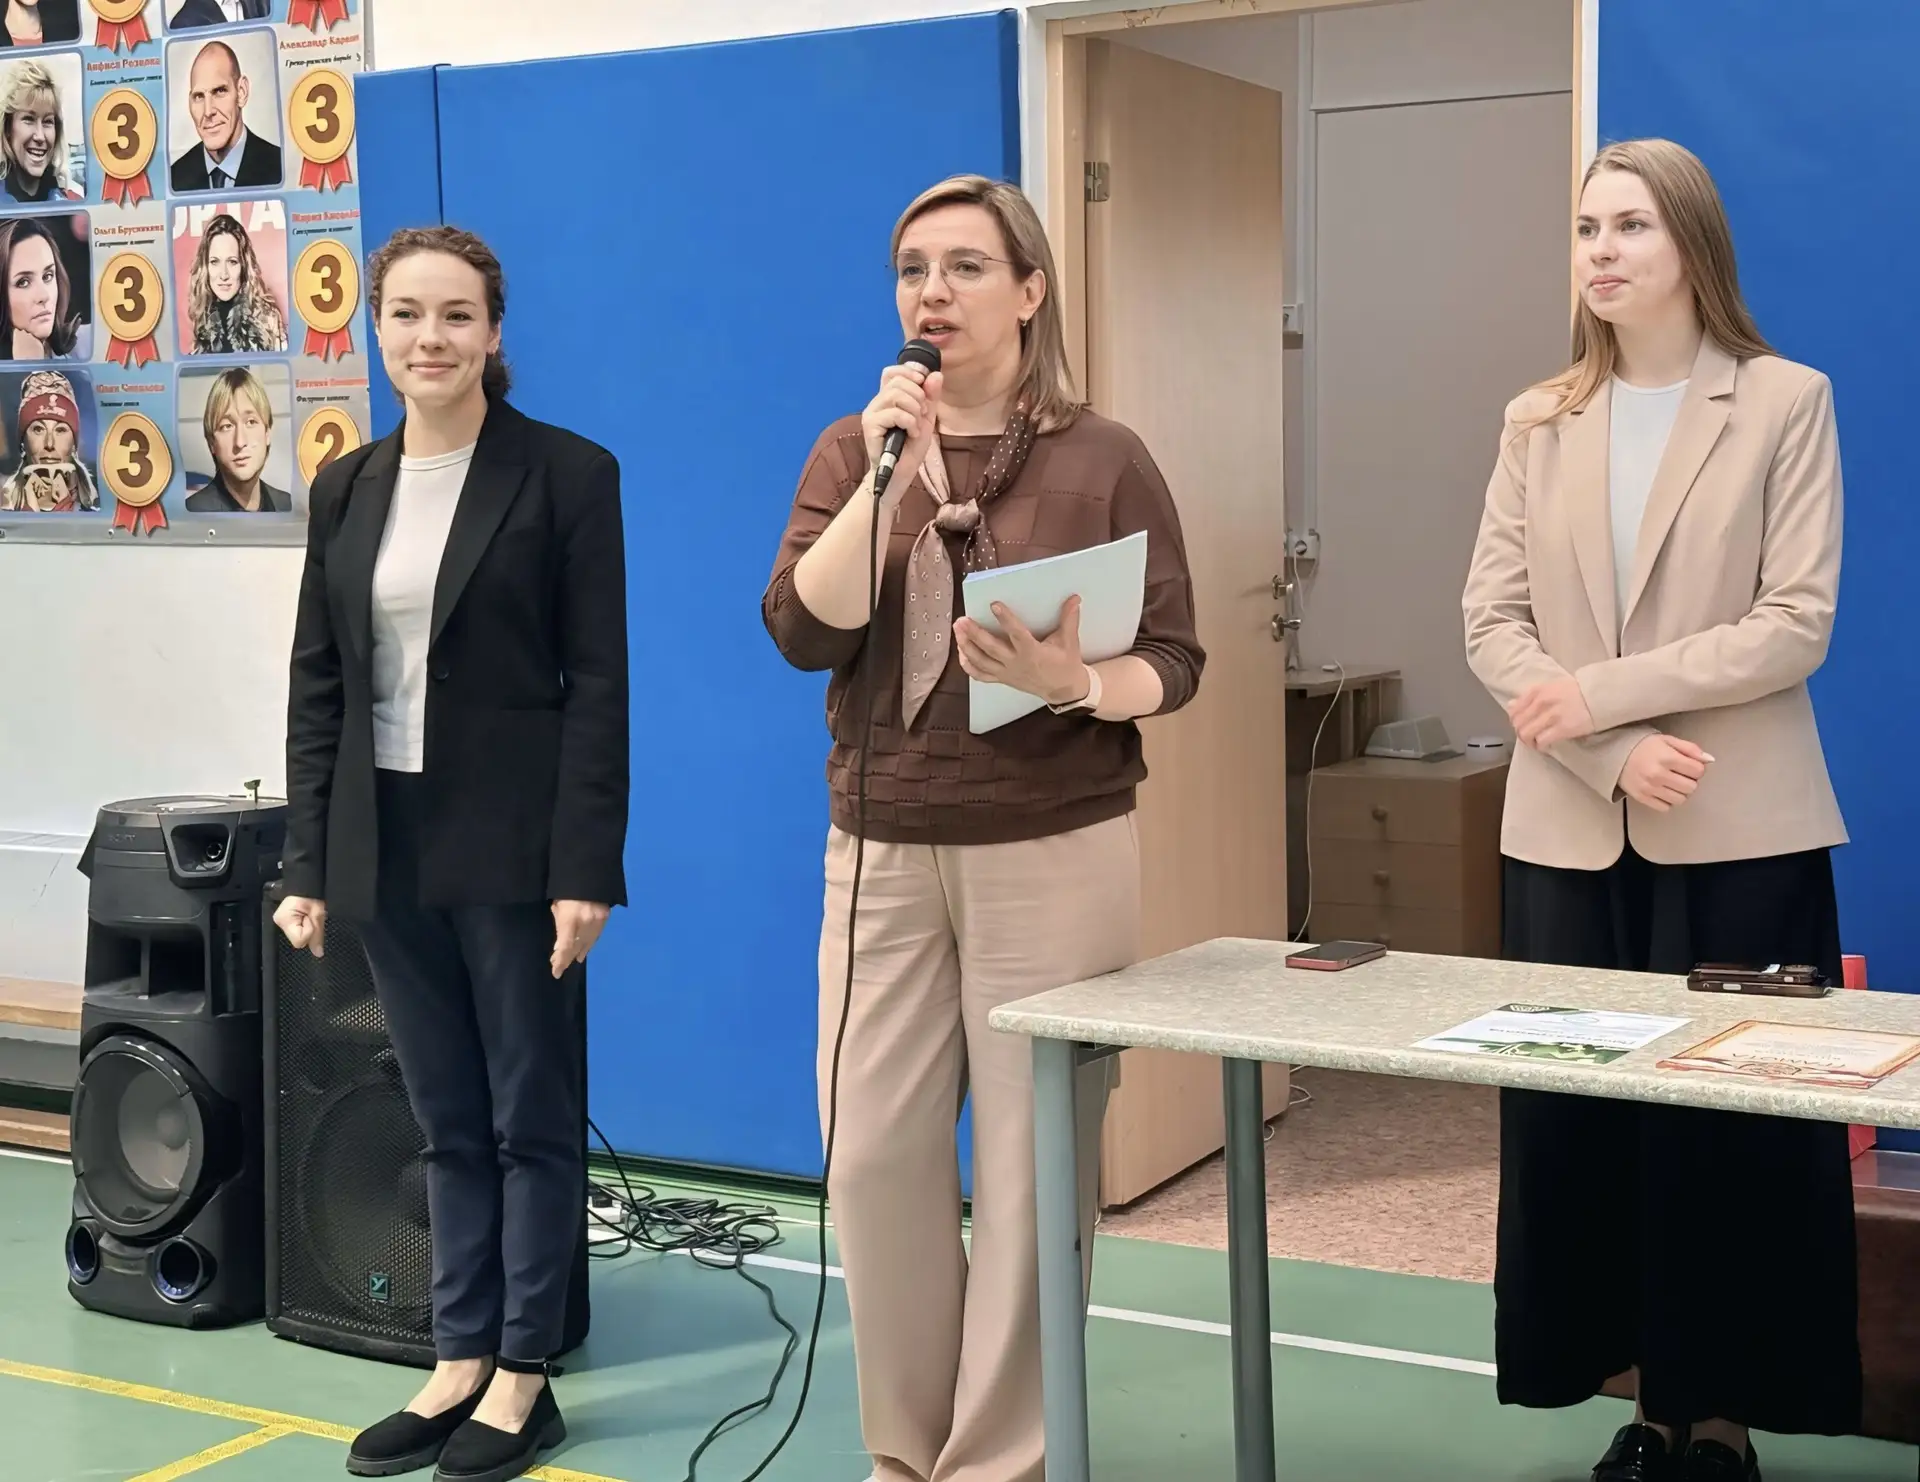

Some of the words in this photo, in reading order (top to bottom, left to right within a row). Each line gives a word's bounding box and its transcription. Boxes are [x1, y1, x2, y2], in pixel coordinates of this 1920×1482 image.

[107, 103, 140, 160] 3
[306, 83, 340, 144] 3
[114, 266, 146, 322] 3
[310, 254, 344, 314] 3
[117, 428, 153, 488] 3
[314, 421, 345, 475] 2
